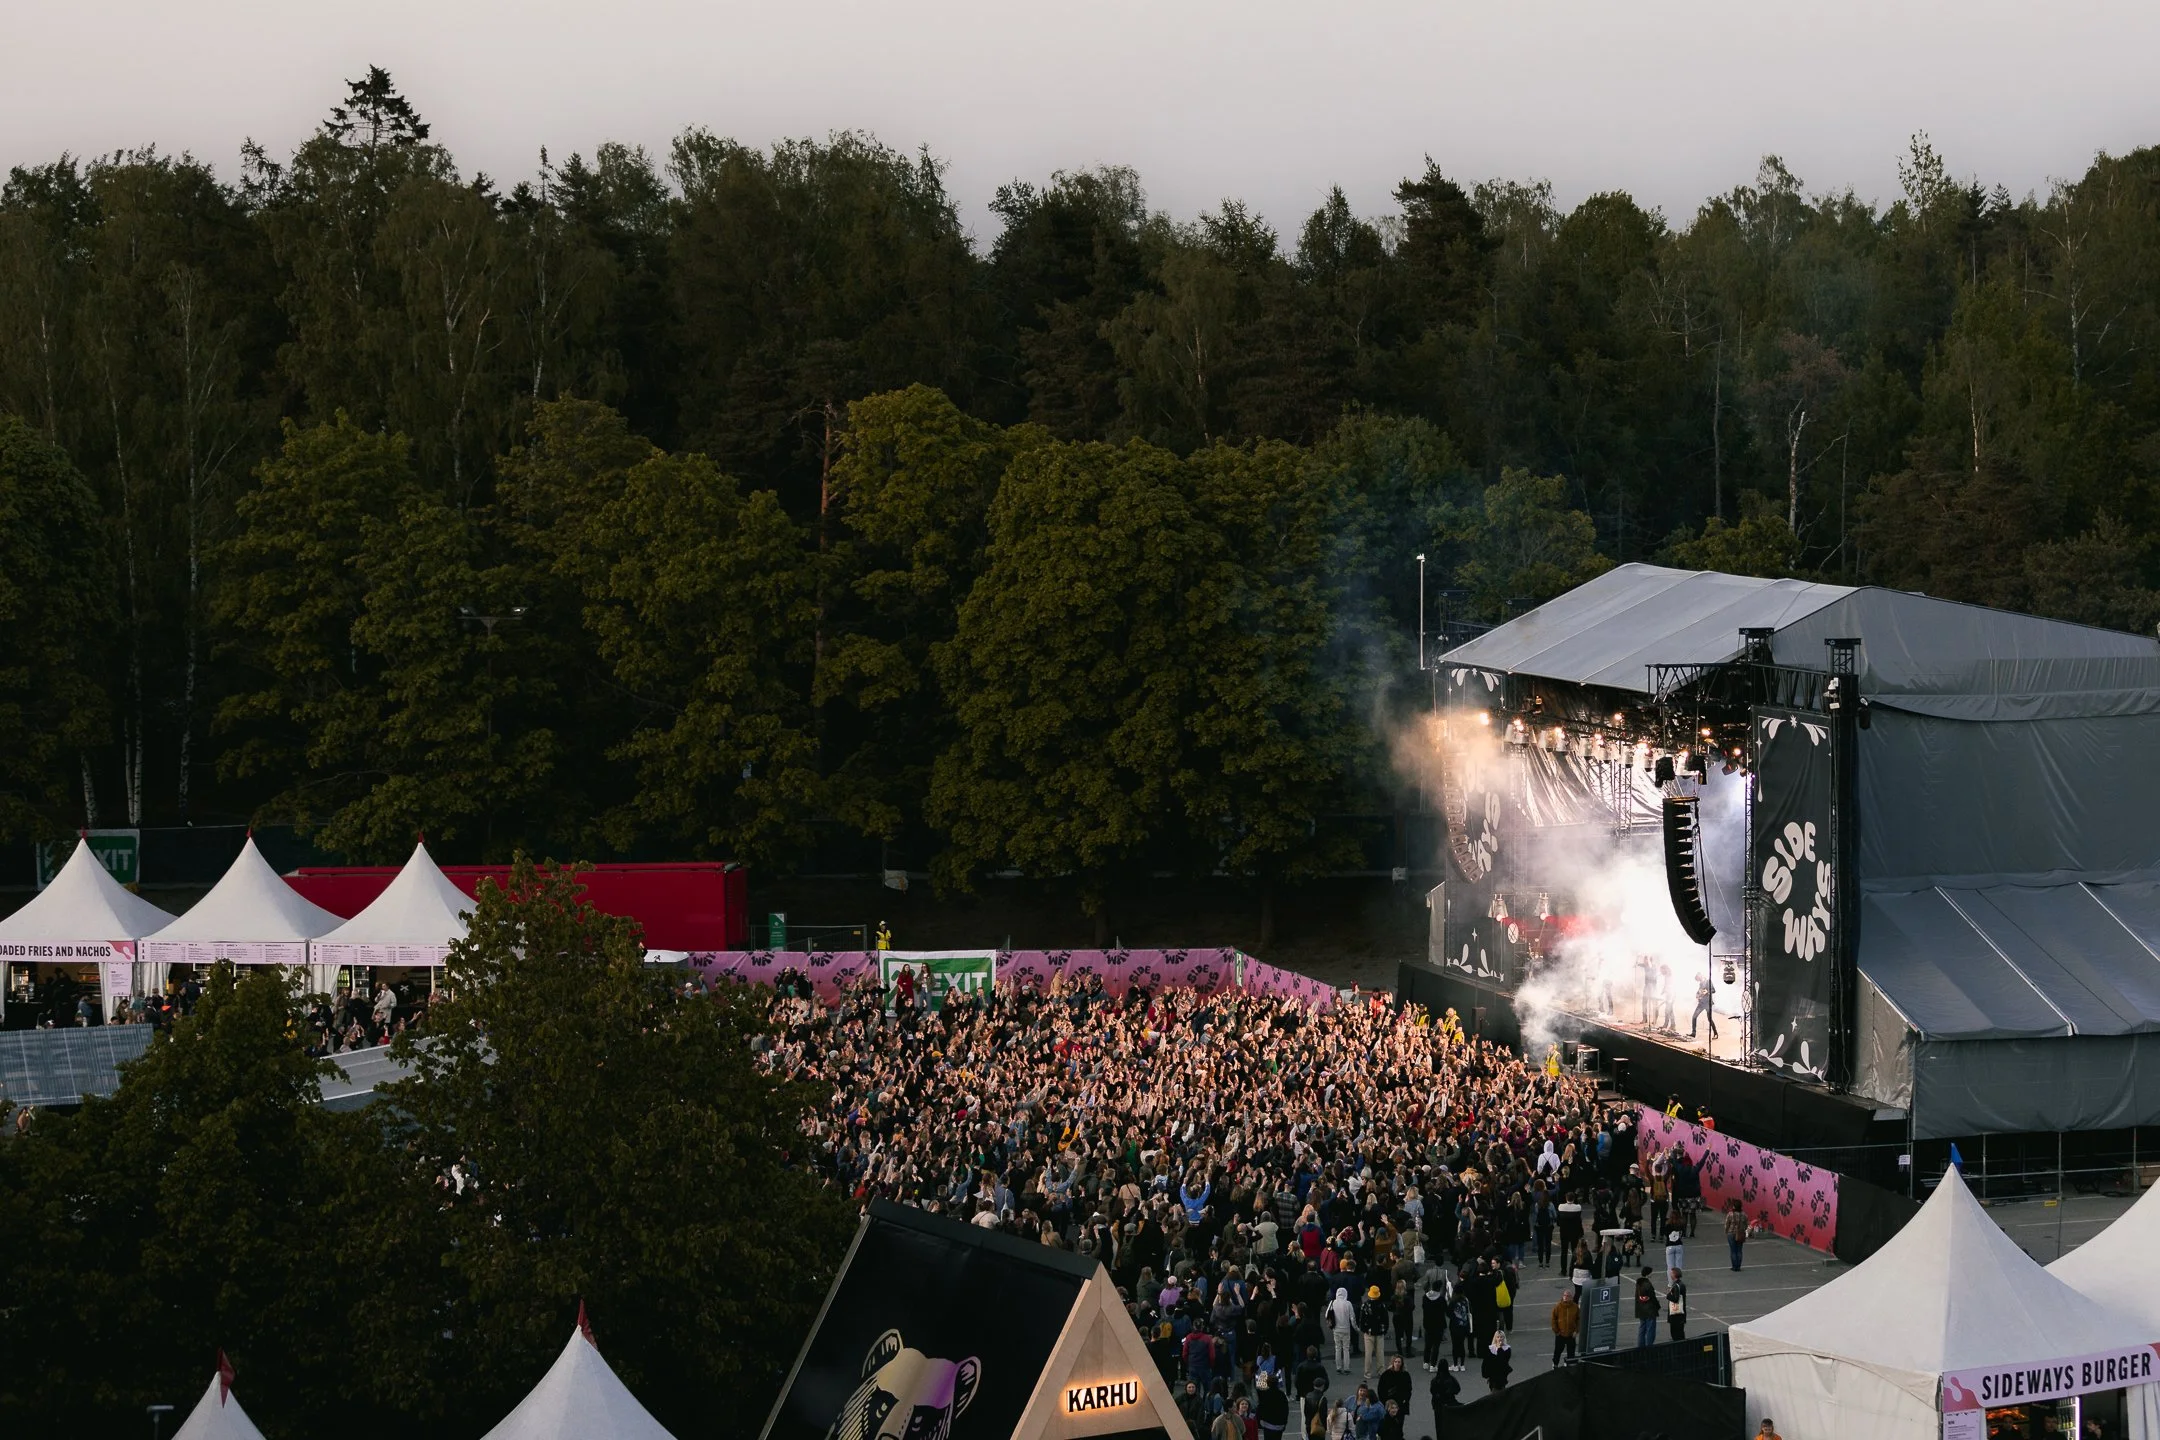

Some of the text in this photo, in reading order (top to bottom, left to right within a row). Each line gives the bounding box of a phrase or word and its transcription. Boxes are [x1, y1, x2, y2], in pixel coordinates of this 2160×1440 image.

[93, 849, 133, 871] XIT
[1762, 821, 1816, 905] SIDE
[1782, 859, 1831, 962] WAYS
[28, 945, 54, 957] FRIES
[55, 946, 74, 957] AND
[76, 946, 111, 957] NACHOS
[692, 952, 716, 967] WAY
[751, 952, 775, 967] WAY
[810, 952, 834, 967] WAY
[1048, 951, 1072, 966] WAY
[1107, 950, 1130, 966] WAY
[1165, 950, 1188, 965] WAY
[832, 968, 856, 988] SIDE
[930, 971, 988, 998] EXIT
[1014, 966, 1035, 987] SIDE
[1129, 965, 1152, 985] SIDE
[1187, 964, 1210, 985] SIDE
[1706, 1152, 1720, 1174] SIDE
[1740, 1164, 1753, 1187] SIDE
[1773, 1177, 1789, 1200] SIDE
[1777, 1189, 1795, 1217] WAYS
[1810, 1189, 1825, 1213] SIDE
[1813, 1202, 1830, 1230] WAYS
[1602, 1290, 1609, 1301] P
[1982, 1352, 2151, 1401] SIDEWAYS BURGER
[1069, 1381, 1138, 1413] KARHU
